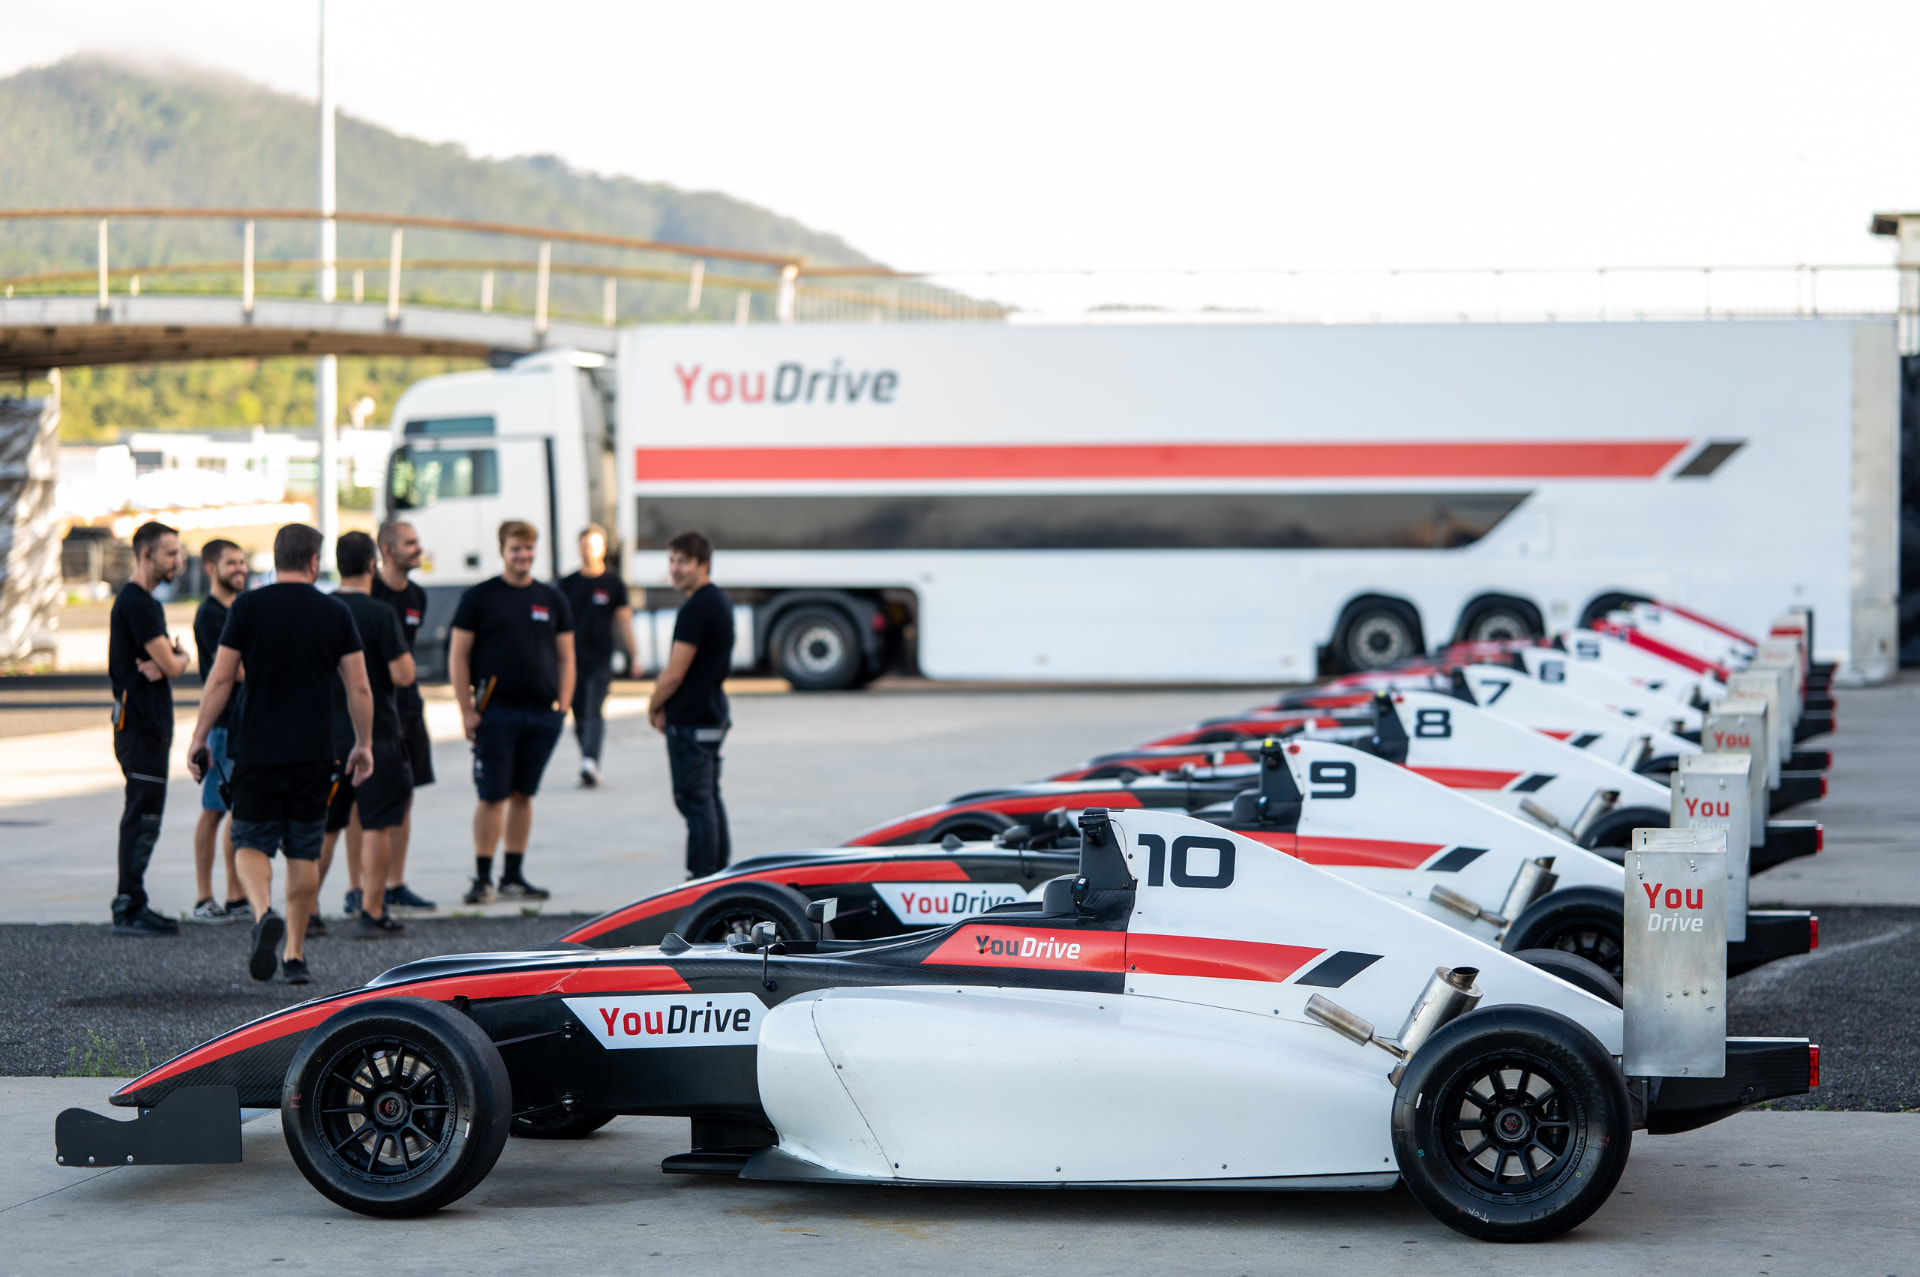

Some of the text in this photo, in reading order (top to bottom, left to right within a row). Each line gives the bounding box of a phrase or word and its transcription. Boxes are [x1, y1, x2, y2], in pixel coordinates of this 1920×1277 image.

[674, 358, 899, 404] YouDrive
[1540, 661, 1565, 683] 6
[1480, 679, 1511, 705] 7
[1415, 709, 1452, 738] 8
[1713, 730, 1750, 749] You
[1310, 761, 1356, 799] 9
[1685, 798, 1730, 817] You
[1138, 833, 1236, 889] 10
[1643, 883, 1703, 909] You
[1648, 913, 1704, 932] Drive
[976, 935, 1081, 959] YouDrive
[600, 1001, 751, 1038] YouDrive
